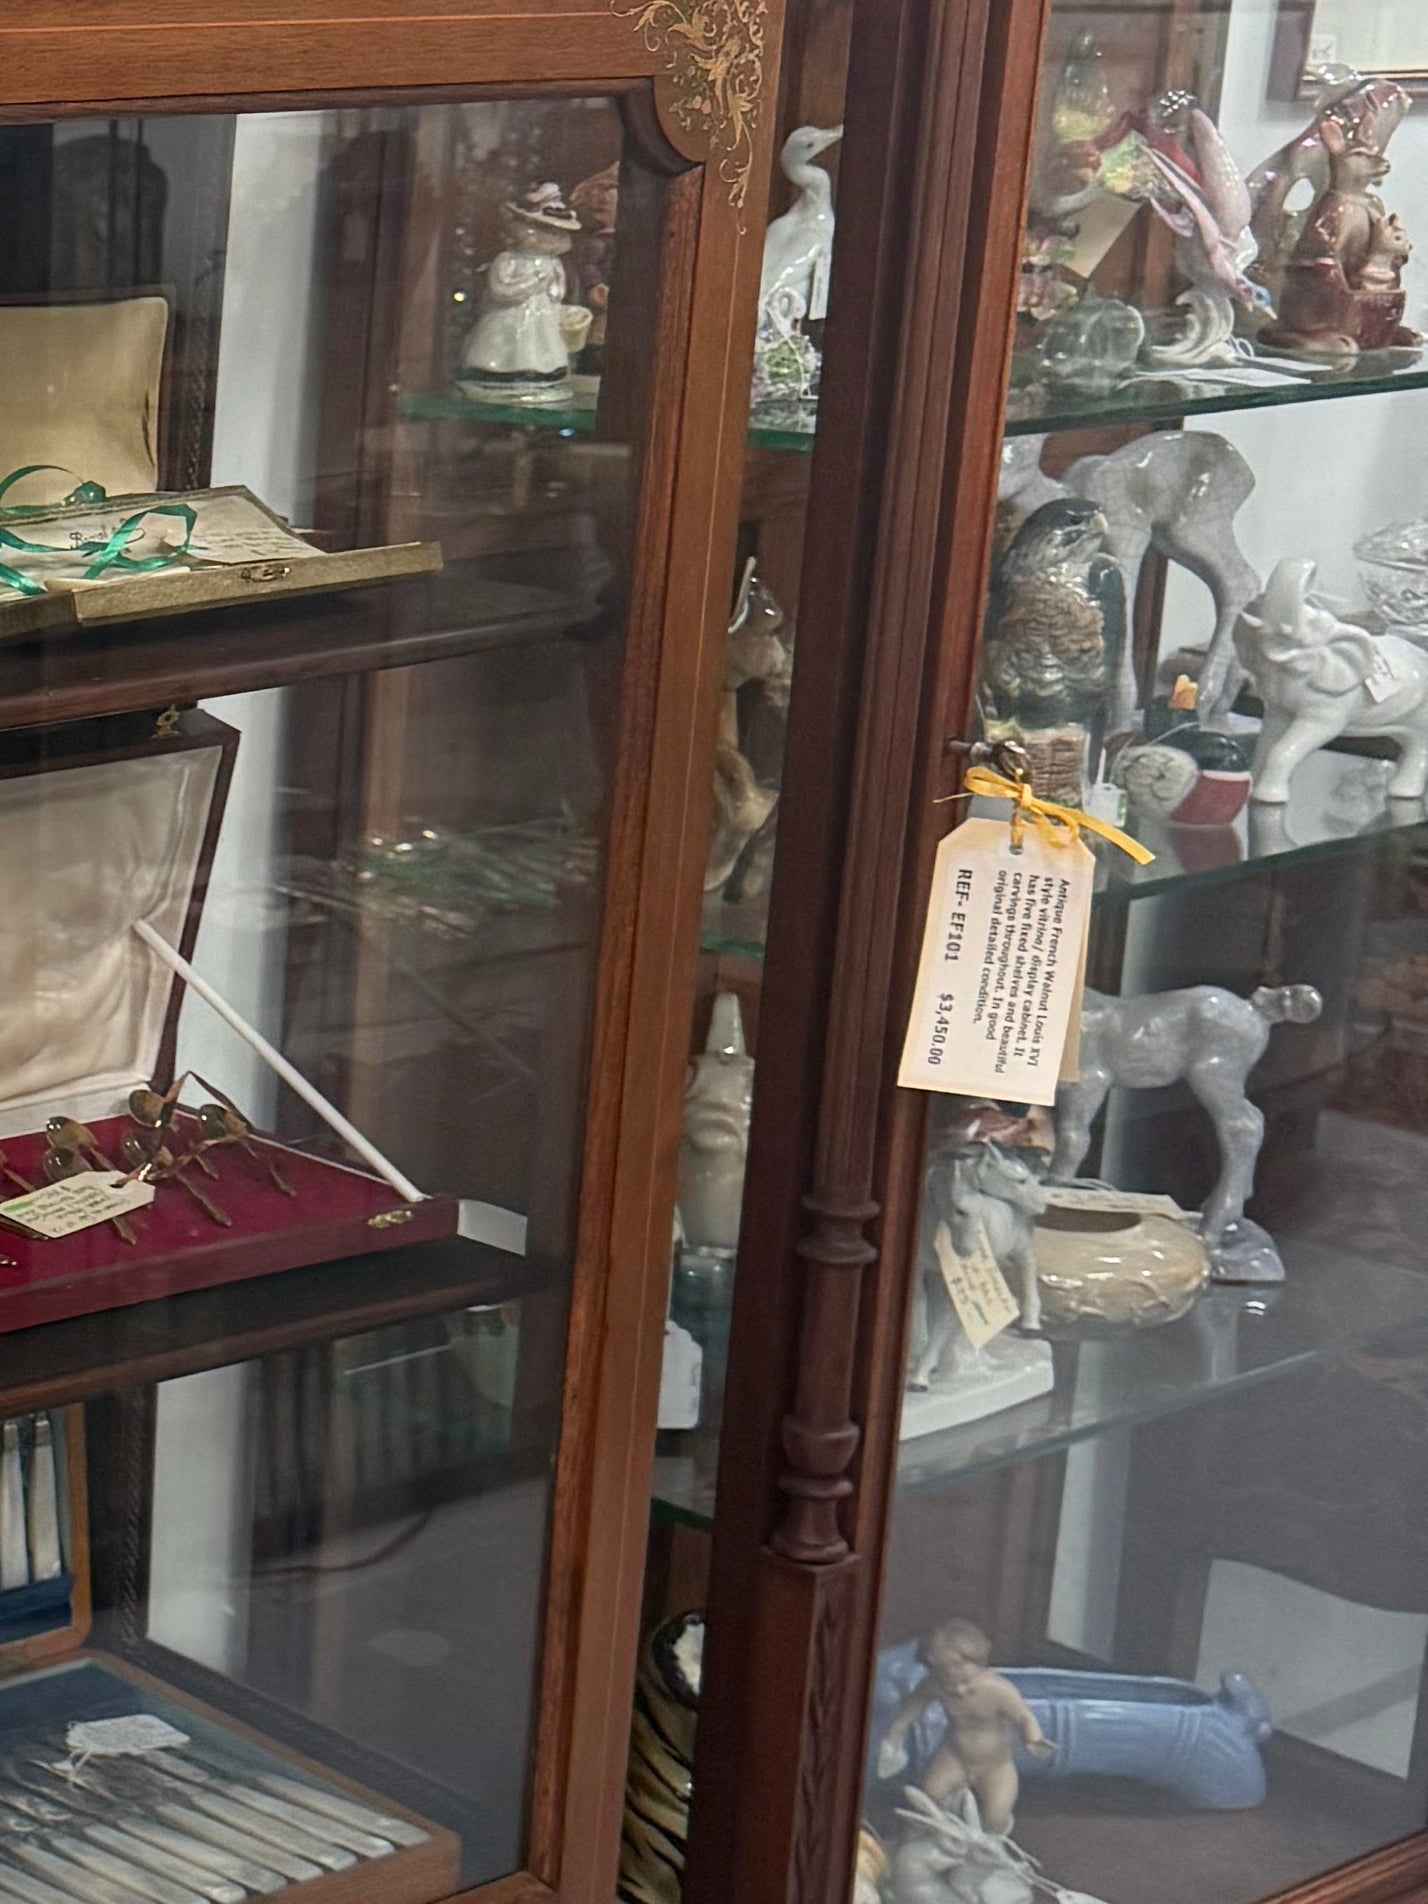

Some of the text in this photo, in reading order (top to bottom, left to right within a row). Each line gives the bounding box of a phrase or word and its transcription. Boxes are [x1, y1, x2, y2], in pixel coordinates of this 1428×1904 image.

[1026, 874, 1040, 896] has
[1040, 877, 1053, 905] style
[944, 868, 973, 962] REF- EF101
[1022, 898, 1036, 919] five
[972, 870, 1008, 1024] original detailed condition.
[985, 872, 1023, 1041] carvings throughout. In good
[1009, 956, 1026, 998] shelves
[1025, 955, 1042, 997] display
[1027, 879, 1071, 1067] Antique French Walnut Louis XVI
[927, 992, 955, 1066] $3,450.00
[1003, 1001, 1017, 1023] and
[994, 1025, 1014, 1074] beautiful
